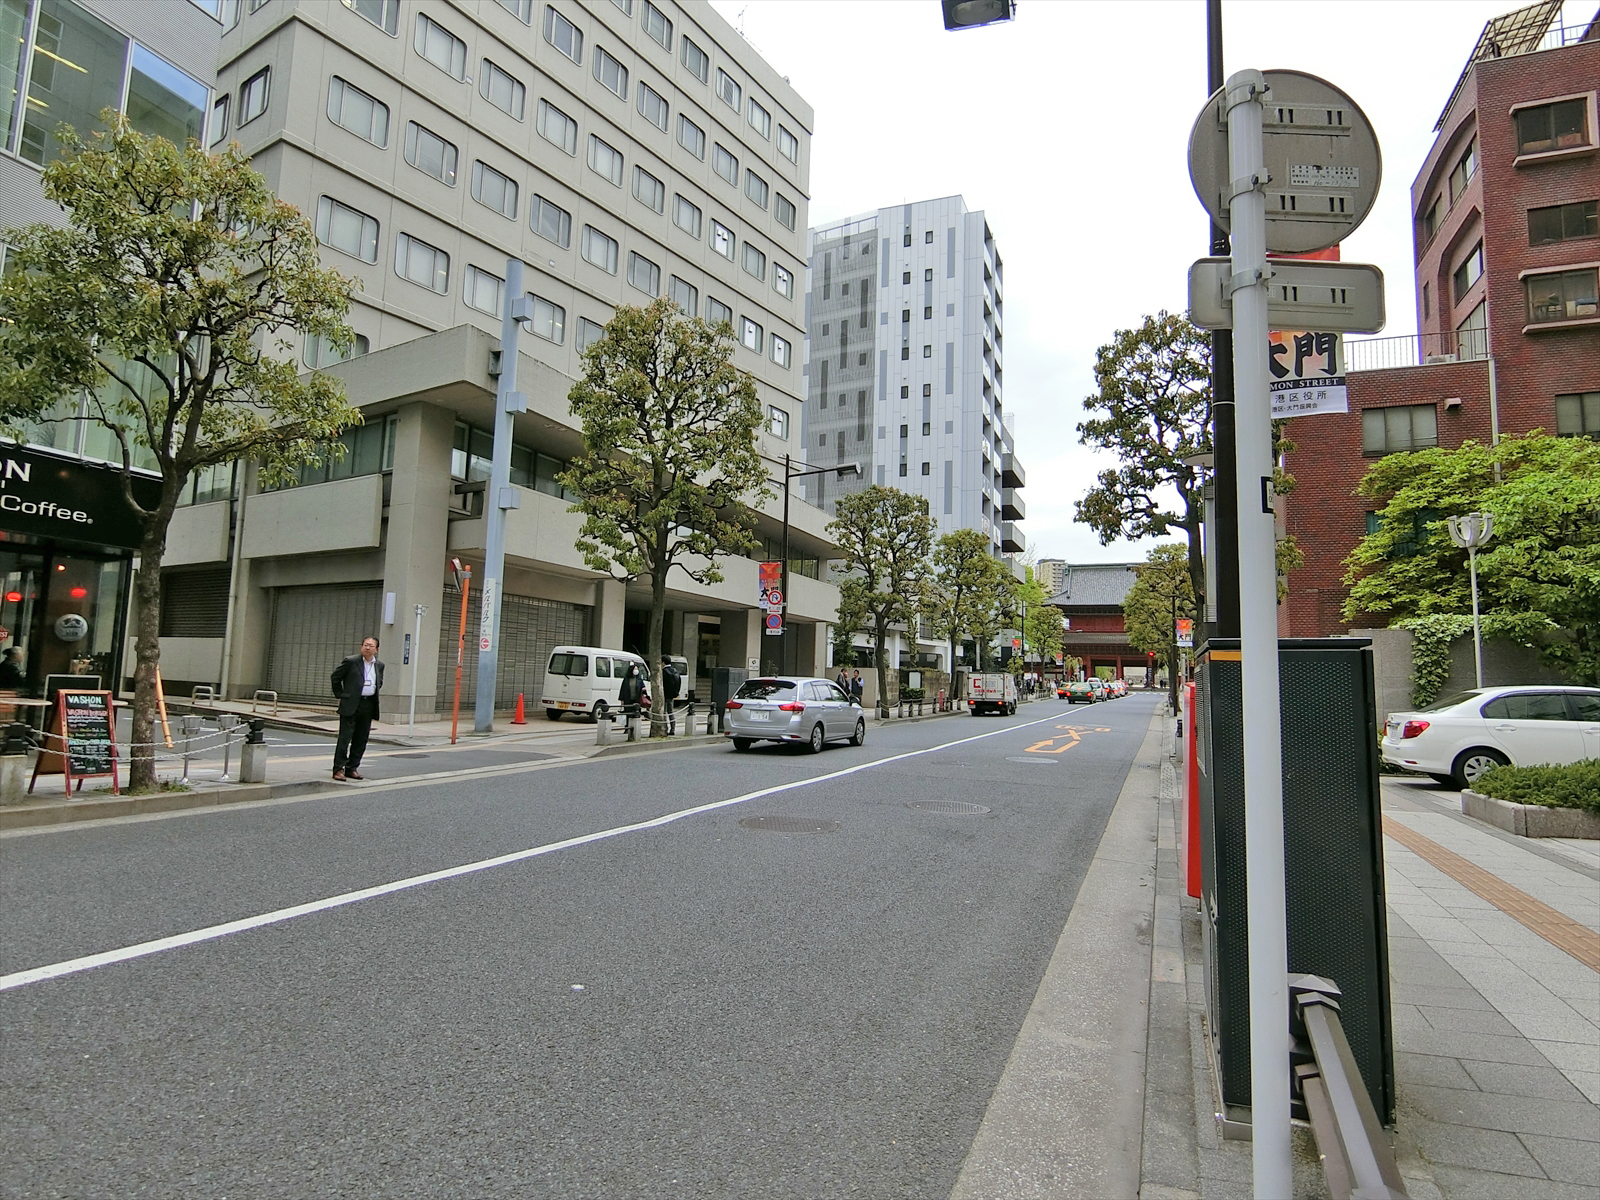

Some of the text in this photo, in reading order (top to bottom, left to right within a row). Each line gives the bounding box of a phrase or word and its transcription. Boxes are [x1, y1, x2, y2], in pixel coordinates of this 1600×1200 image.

[1299, 379, 1338, 388] STREET
[1275, 390, 1327, 404] 港区役所
[0, 458, 31, 482] N
[482, 588, 492, 623] メルパルク
[67, 695, 102, 704] VASHON
